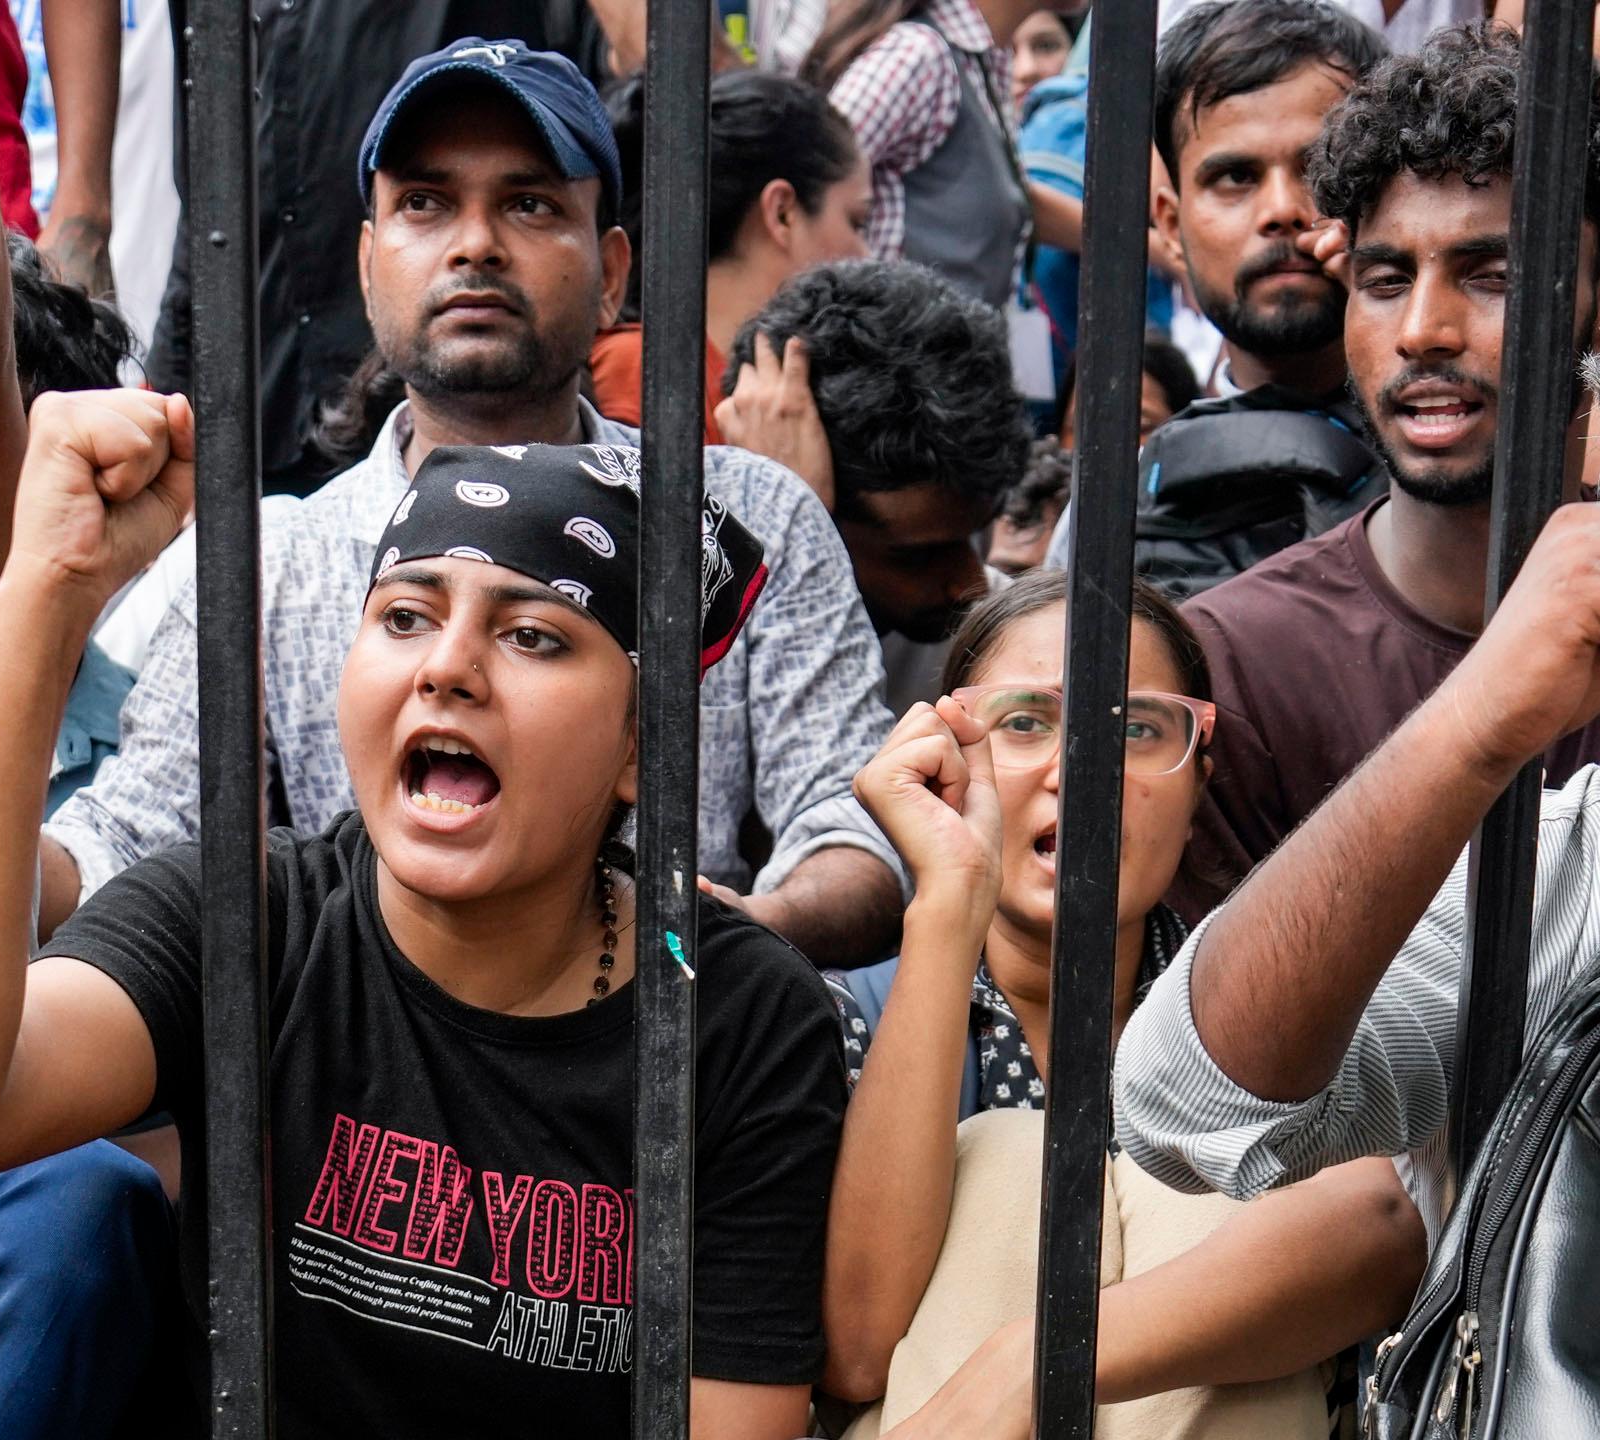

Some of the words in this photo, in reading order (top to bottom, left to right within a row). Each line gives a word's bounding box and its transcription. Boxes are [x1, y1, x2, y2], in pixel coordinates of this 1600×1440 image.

[304, 1113, 474, 1268] NEW
[290, 1236, 315, 1255] Where
[314, 1246, 343, 1262] passion
[344, 1256, 366, 1272] meets
[364, 1266, 409, 1284] persistance
[409, 1275, 442, 1293] Crafting
[442, 1283, 473, 1299] legends
[473, 1292, 491, 1306] with
[305, 1258, 328, 1271] move
[327, 1263, 348, 1281] Every
[348, 1273, 375, 1290] second
[404, 1289, 427, 1304] every
[426, 1293, 443, 1307] step
[444, 1300, 473, 1314] matters
[319, 1275, 352, 1296] potential
[352, 1289, 383, 1307] through
[383, 1298, 420, 1315] powerful
[419, 1308, 474, 1329] performances
